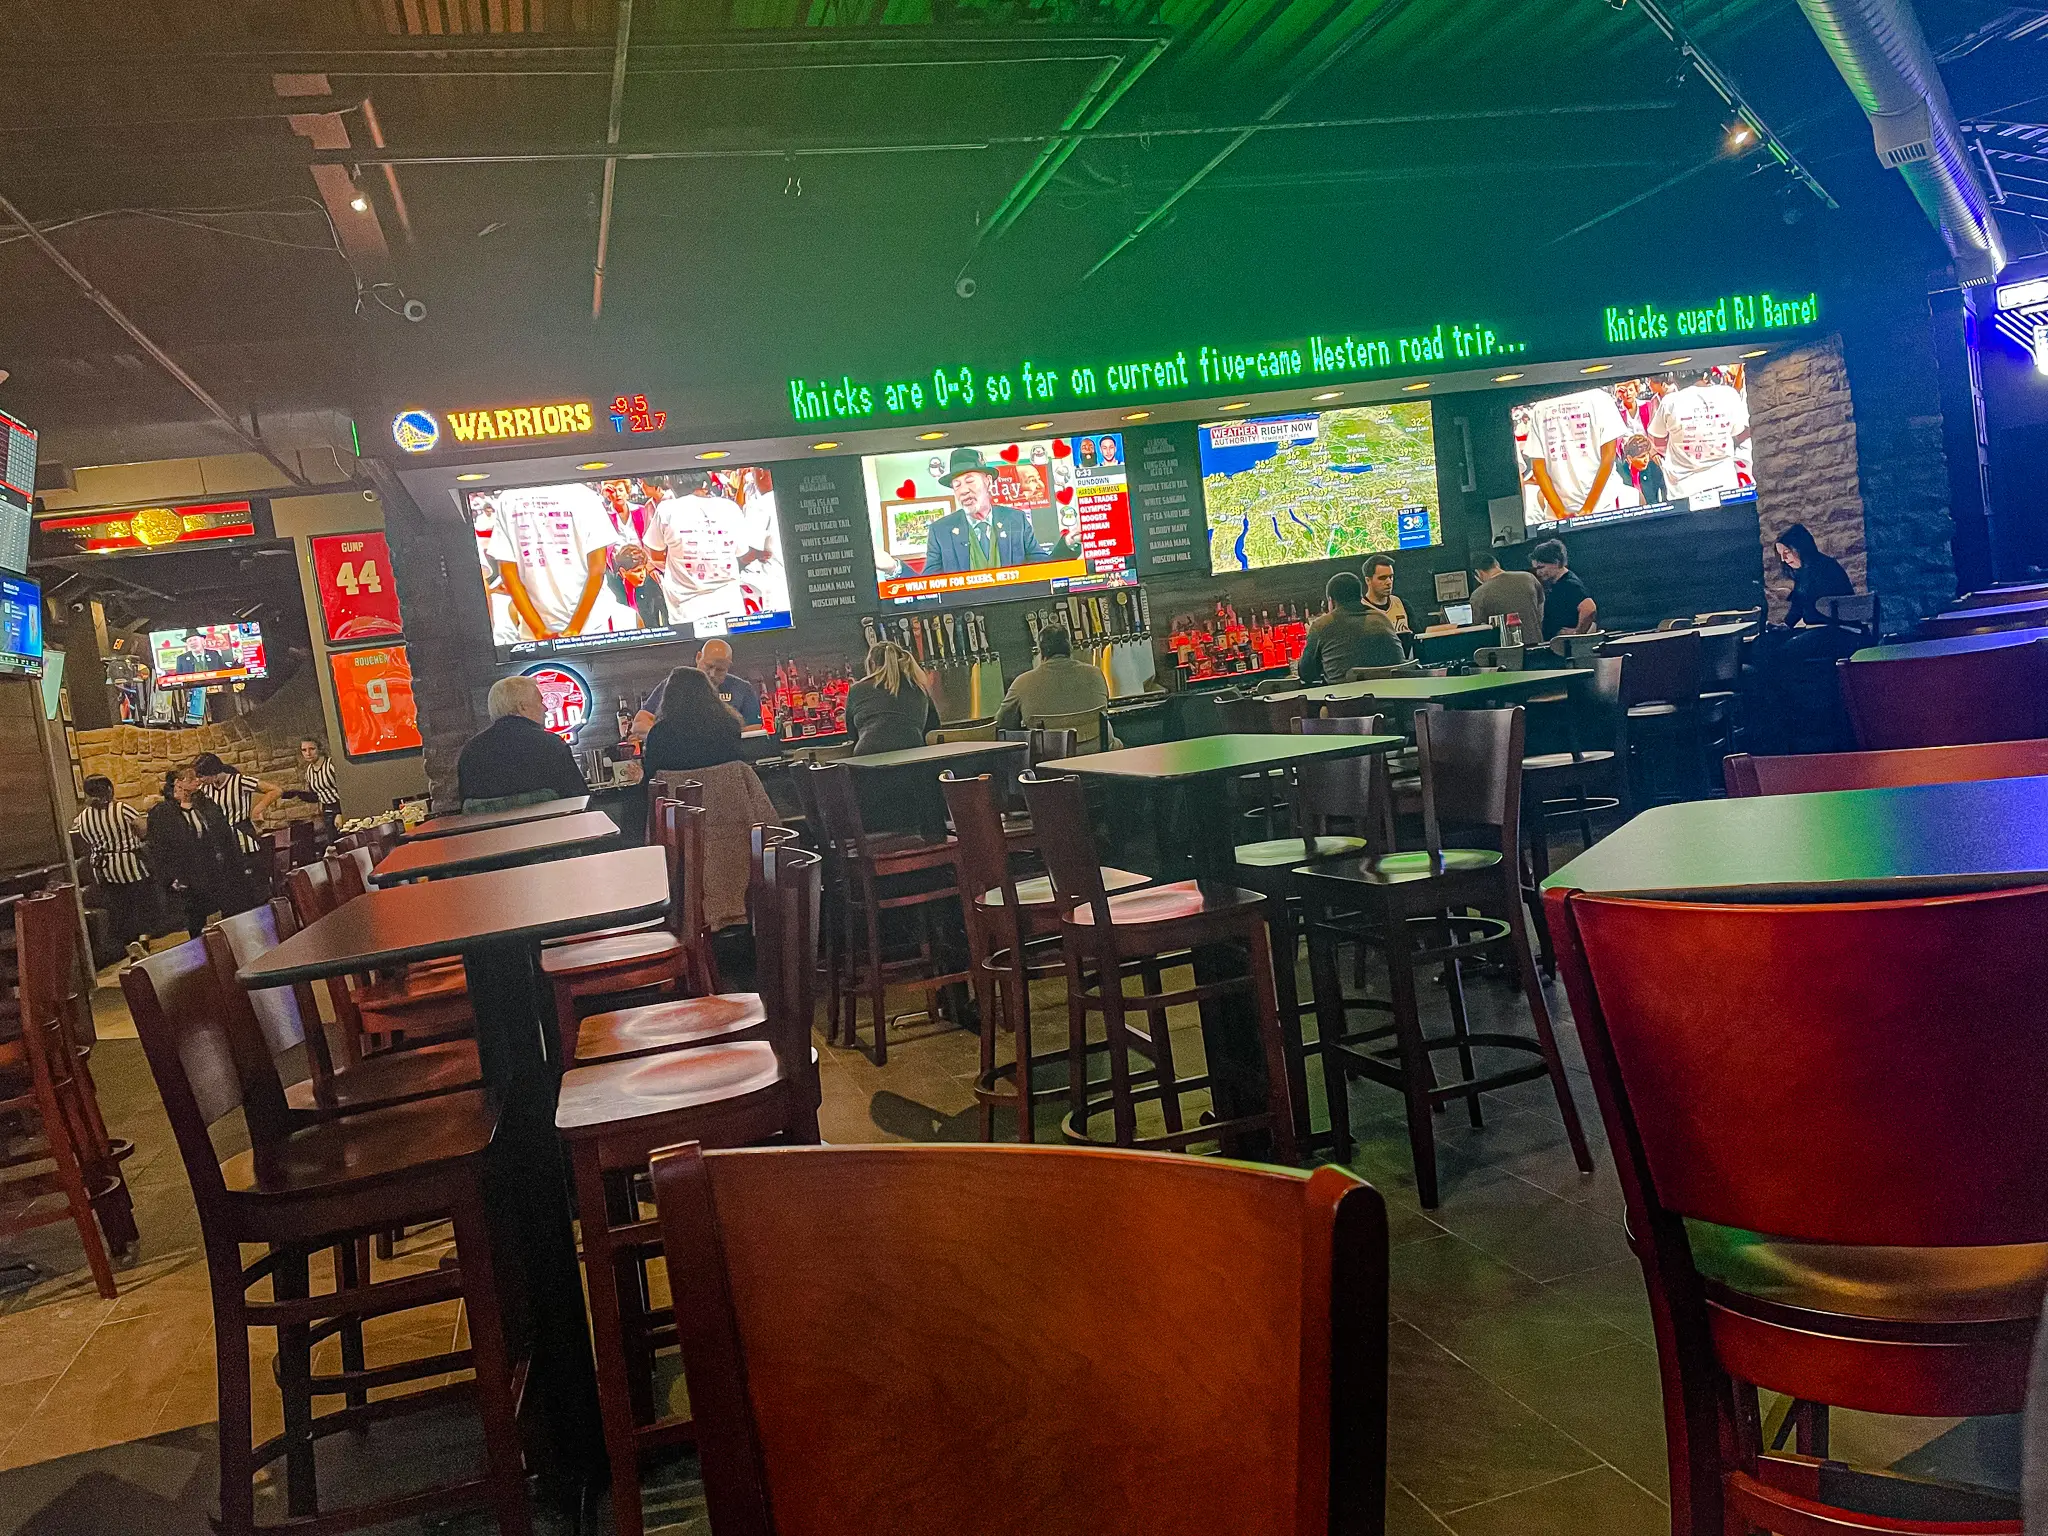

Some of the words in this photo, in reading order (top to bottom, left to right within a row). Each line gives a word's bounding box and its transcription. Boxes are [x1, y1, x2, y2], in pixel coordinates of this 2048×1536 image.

[1606, 305, 1668, 342] Knicks
[1677, 298, 1727, 335] guard
[1733, 295, 1755, 330] RJ
[790, 377, 872, 419] Knicks
[885, 381, 923, 411] are
[934, 366, 973, 406] 0-3
[987, 373, 1011, 402] so
[1022, 361, 1058, 398] far
[1071, 368, 1096, 394] on
[1107, 352, 1188, 391] current
[1200, 346, 1301, 383] five-game
[1311, 337, 1391, 372] Western
[1400, 325, 1444, 363] road
[609, 395, 648, 414] -9.5
[447, 404, 592, 441] WARRIORS
[610, 415, 624, 432] T
[629, 412, 667, 432] 217
[1212, 425, 1257, 438] WEATHER
[1261, 424, 1288, 436] RIGHT
[1291, 422, 1313, 432] NOW
[1214, 435, 1256, 446] AUTHORITY
[988, 475, 1021, 498] day
[1078, 477, 1109, 486] RUNDOWN
[817, 497, 839, 507] ISLAND
[1079, 496, 1093, 504] NBA
[1094, 494, 1118, 502] TRADES
[822, 505, 834, 514] TEA
[1080, 504, 1112, 513] OLYMPICS
[1179, 508, 1190, 517] LINE
[795, 522, 819, 532] PURPLE
[820, 520, 837, 530] TIGER
[1082, 522, 1110, 531] NORMAN
[1172, 523, 1187, 533] MARY
[1403, 516, 1414, 530] 3
[801, 537, 821, 547] WHITE
[1083, 532, 1095, 540] AAF
[341, 542, 364, 552] GUMP
[1084, 541, 1097, 549] NHL
[1098, 538, 1117, 547] NEWS
[1150, 540, 1173, 550] BAHAMA
[1173, 537, 1190, 547] MAMA
[800, 552, 823, 563] FIF-TEA
[823, 551, 840, 560] YARD
[841, 549, 854, 559] LINE
[1085, 549, 1110, 558] ERRORS
[1152, 555, 1175, 565] MOSCOW
[1176, 552, 1191, 561] MULE
[336, 560, 382, 595] 44
[808, 567, 832, 578] BLOODY
[832, 564, 851, 575] MARY
[809, 583, 835, 593] BAHAMA
[836, 580, 855, 590] MAMA
[904, 581, 927, 592] WHAT
[929, 579, 947, 590] NOW
[950, 576, 965, 587] FOR
[966, 574, 995, 585] SIXERS,
[996, 571, 1019, 582] NETS?
[812, 597, 838, 608] MOSCOW
[840, 595, 856, 605] MULE
[354, 654, 389, 666] BOUCHER
[366, 678, 391, 714] 9
